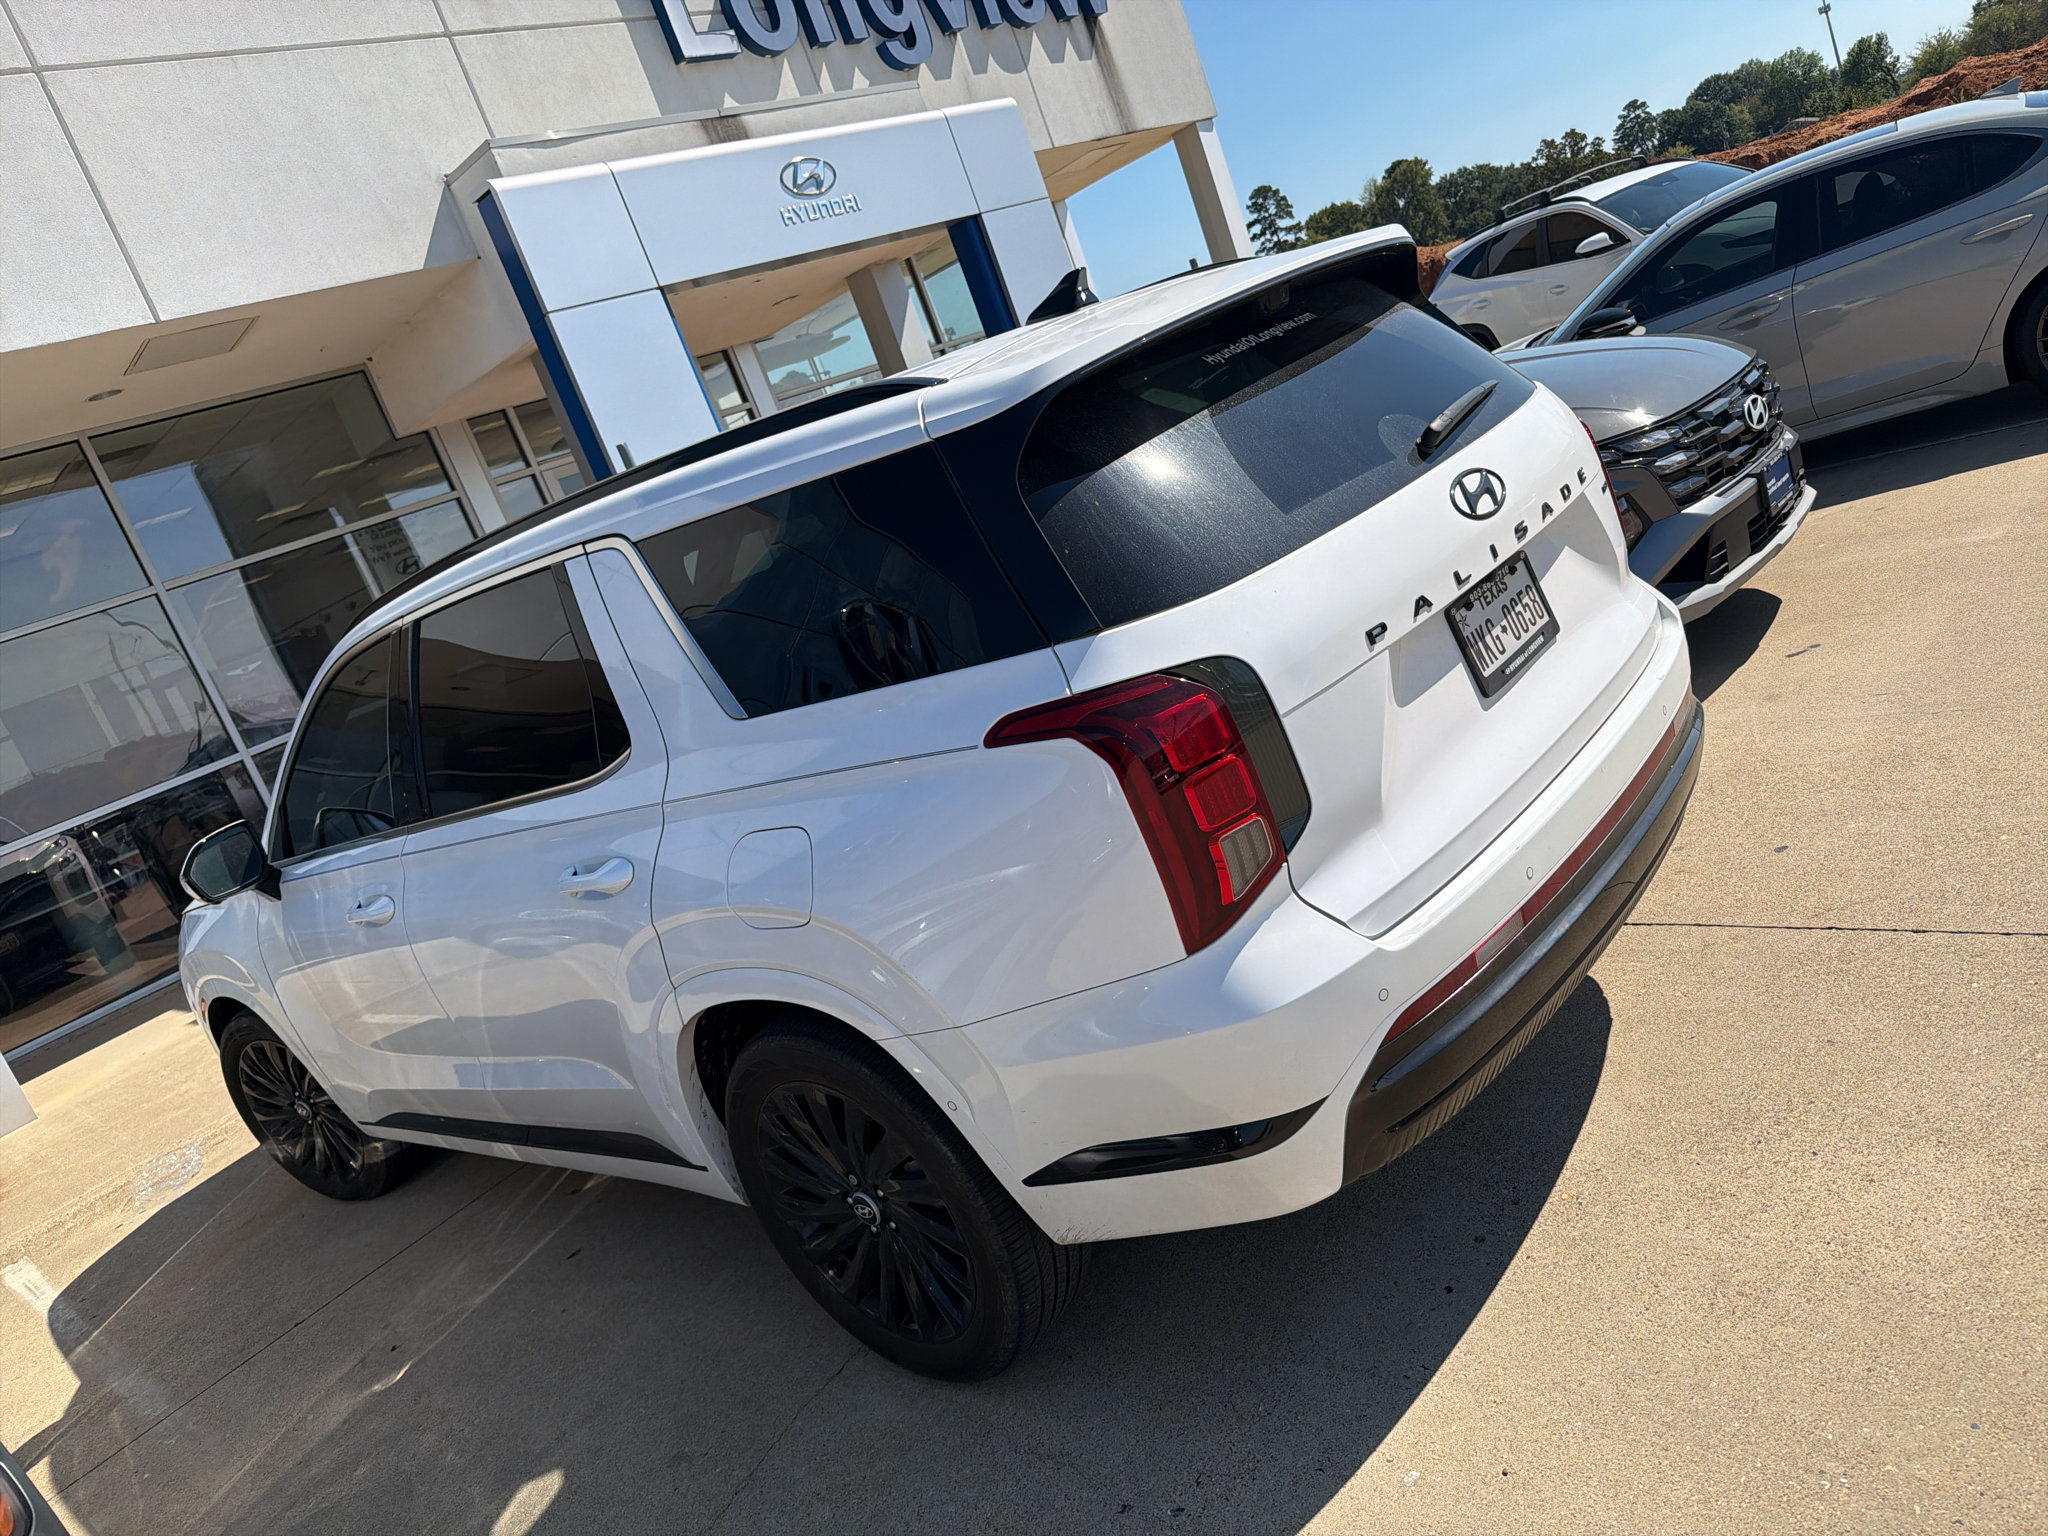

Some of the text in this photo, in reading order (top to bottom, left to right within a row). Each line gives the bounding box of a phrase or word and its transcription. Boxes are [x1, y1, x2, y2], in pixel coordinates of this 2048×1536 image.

[779, 193, 862, 227] HYUNDAI
[1201, 312, 1318, 365] HyundaiOfLongview.com
[1364, 466, 1587, 647] PALISADE
[1478, 580, 1509, 611] TEXAS
[1465, 584, 1545, 673] WKG 0658
